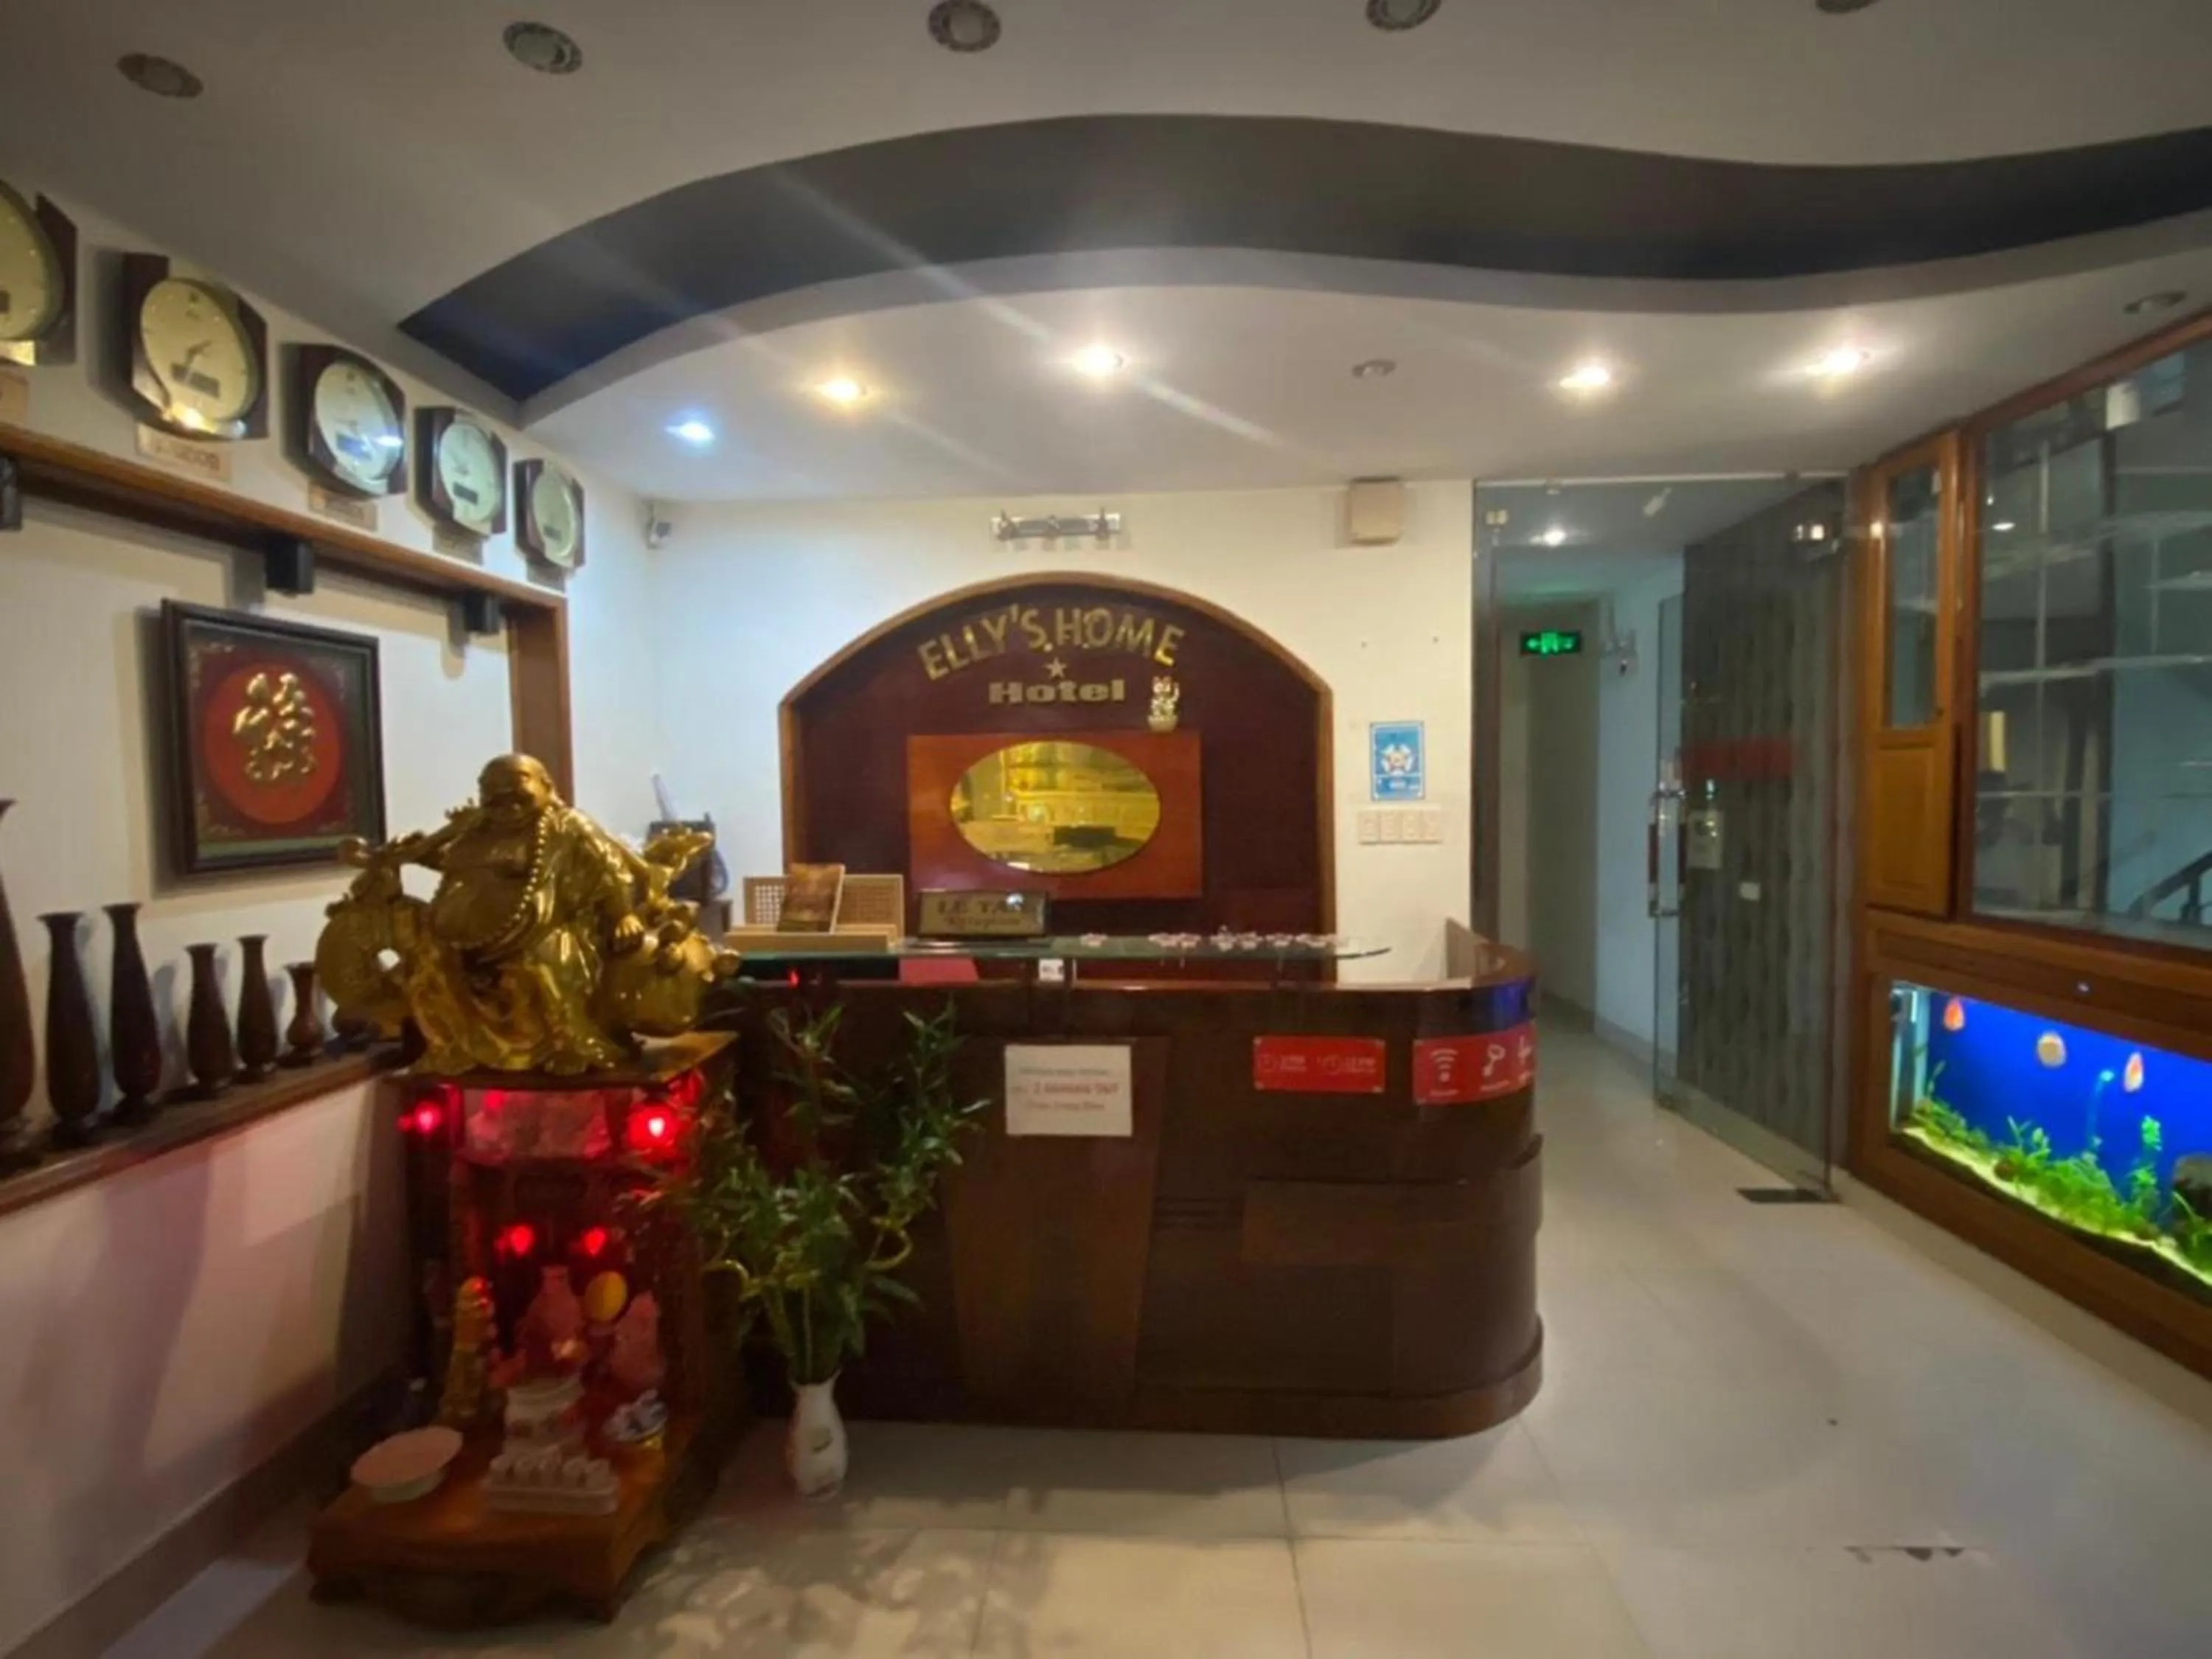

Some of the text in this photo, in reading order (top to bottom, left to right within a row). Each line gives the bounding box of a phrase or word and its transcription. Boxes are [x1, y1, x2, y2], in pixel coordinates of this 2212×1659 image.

[917, 604, 1185, 681] ELLY'S HOME
[988, 678, 1127, 705] Hotel
